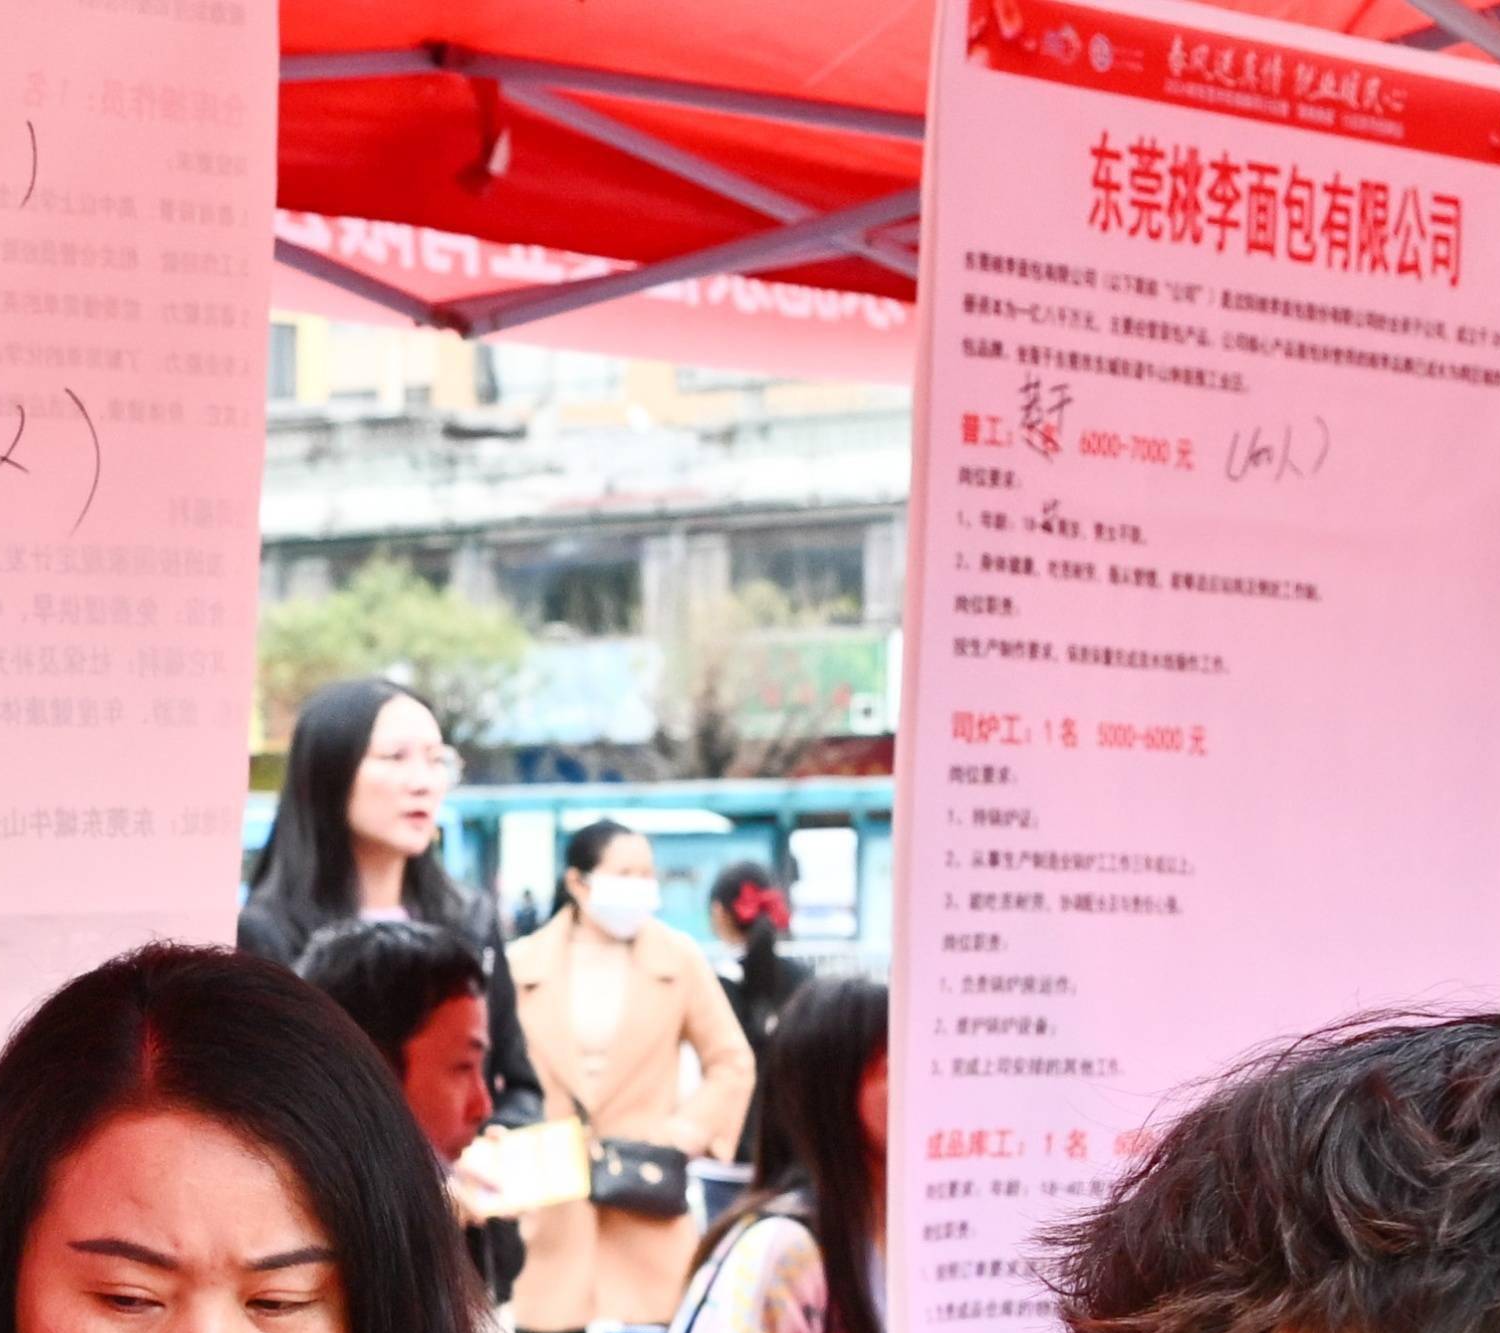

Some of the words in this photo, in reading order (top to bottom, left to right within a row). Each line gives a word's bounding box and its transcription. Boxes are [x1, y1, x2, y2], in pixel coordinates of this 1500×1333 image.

[1087, 130, 1466, 290] 东莞桃李面包有限公司
